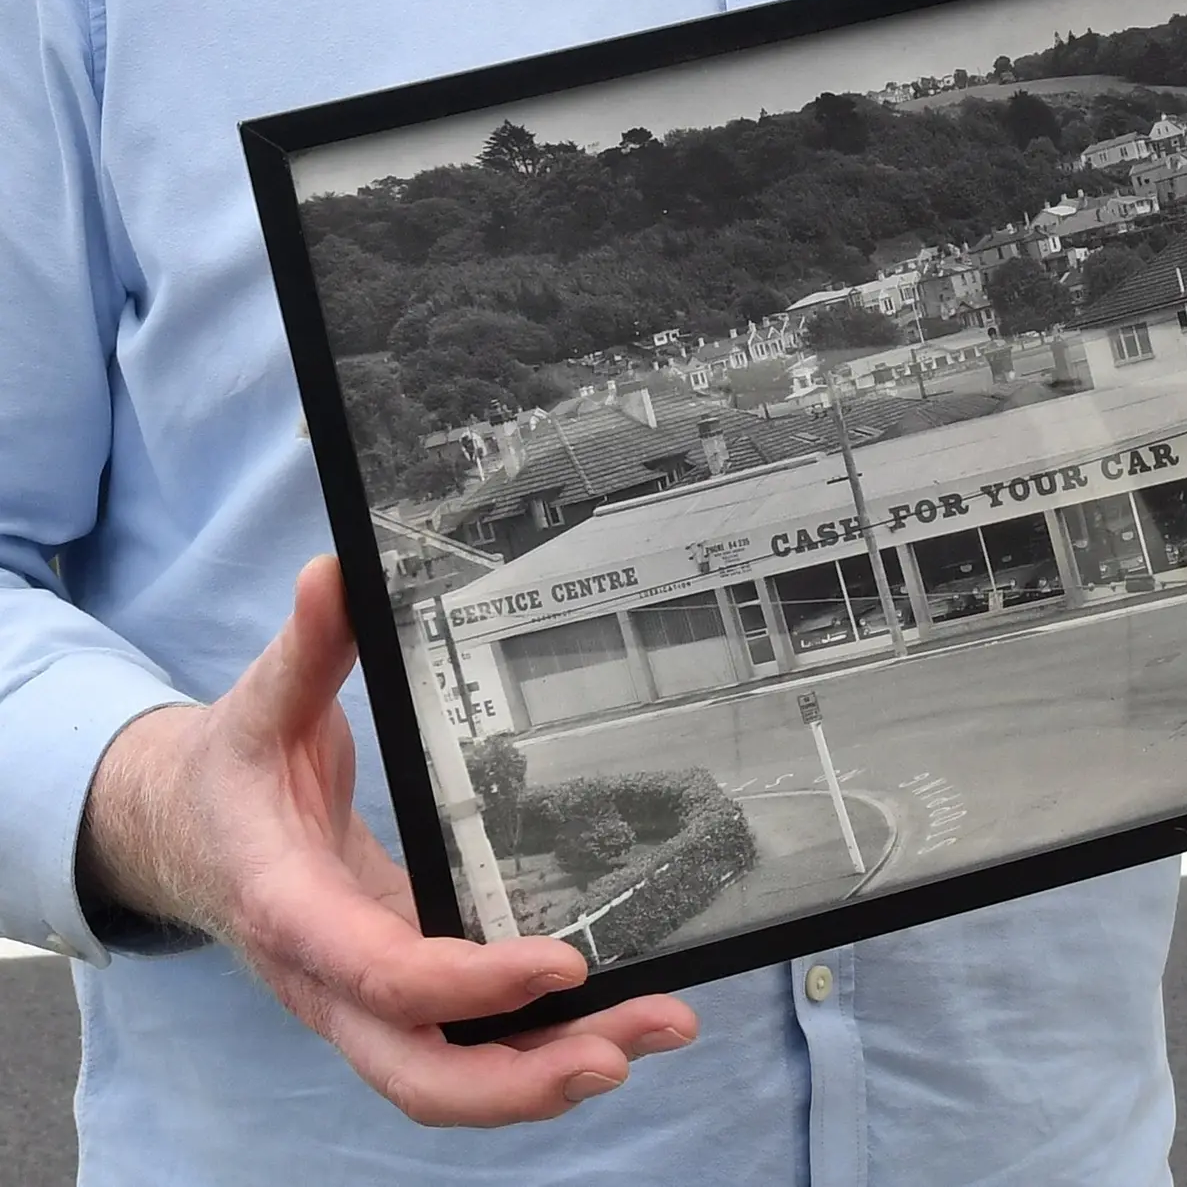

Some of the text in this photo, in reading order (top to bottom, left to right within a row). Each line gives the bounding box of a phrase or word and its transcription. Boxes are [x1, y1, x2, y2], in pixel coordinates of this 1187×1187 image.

[770, 443, 1180, 557] CASH FOR YOUR CAR
[450, 566, 639, 628] SERVICE CENTRE
